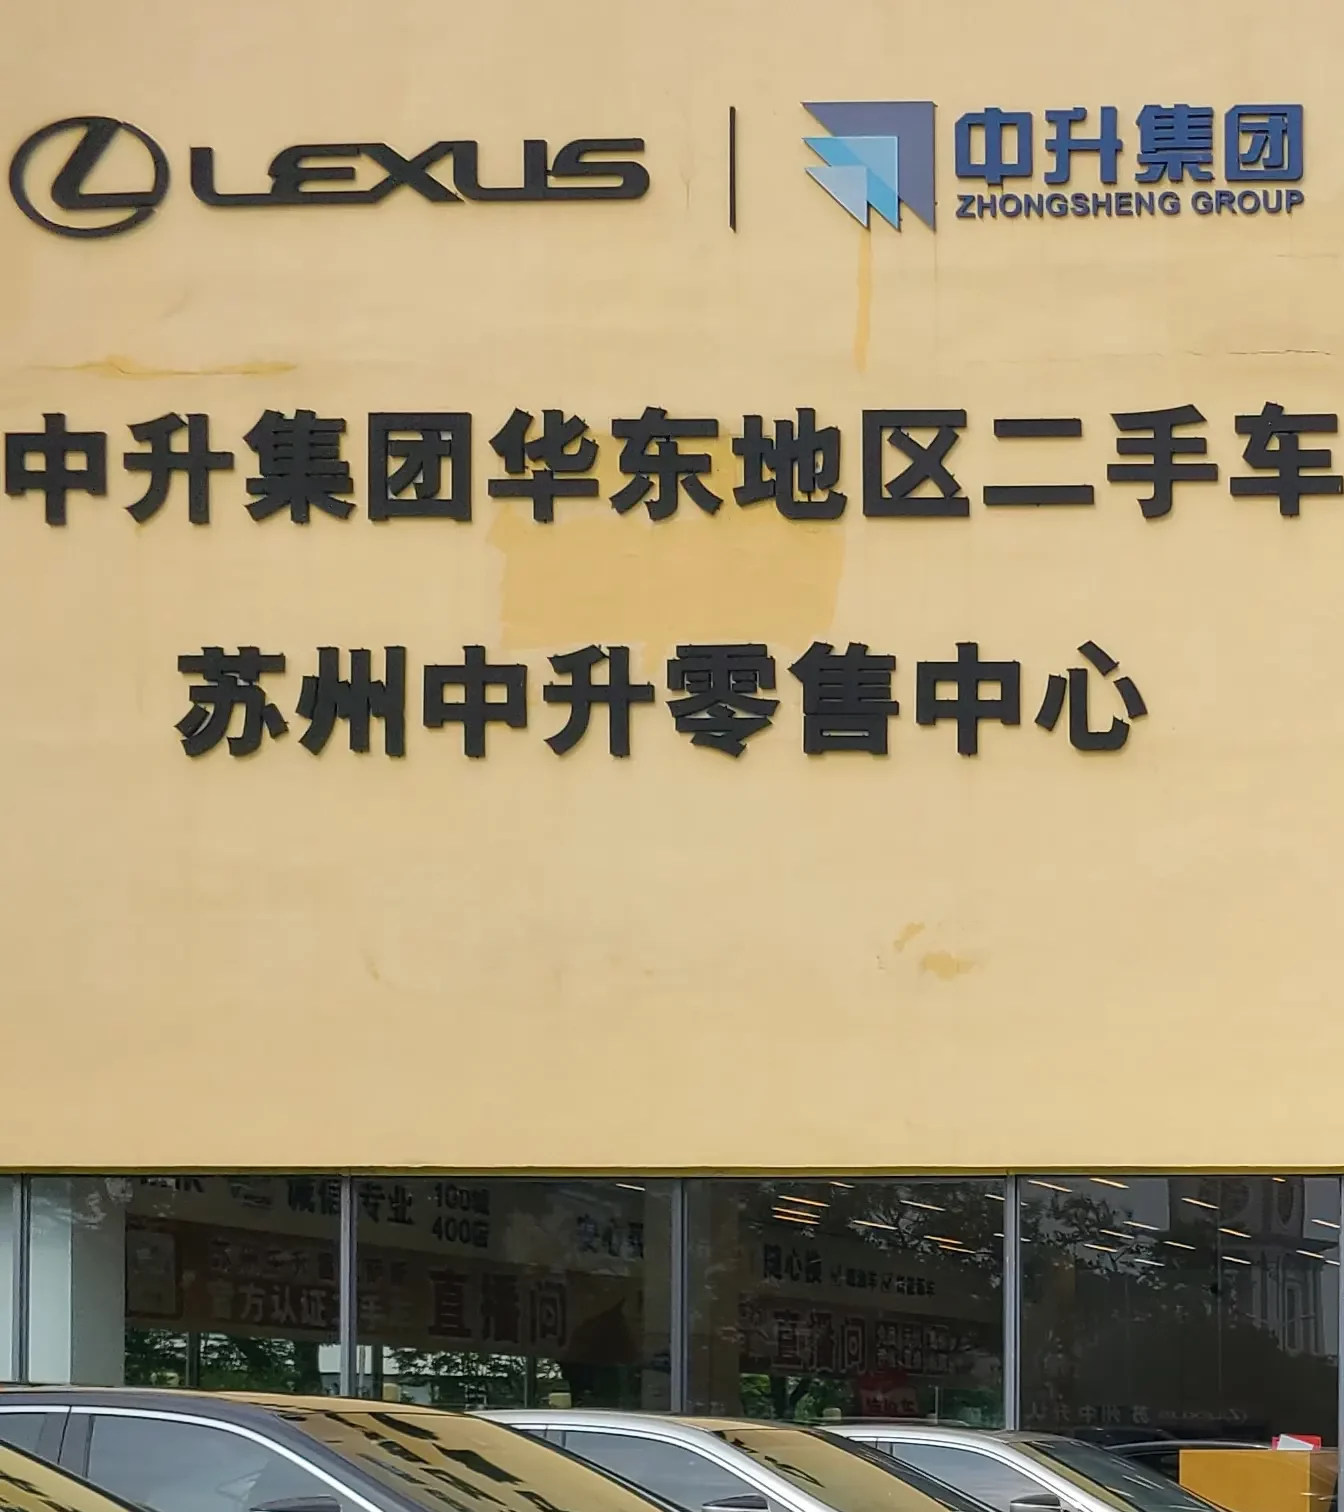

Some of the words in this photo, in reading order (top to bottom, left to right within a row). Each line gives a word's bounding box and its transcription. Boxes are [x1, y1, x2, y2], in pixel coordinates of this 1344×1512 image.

[189, 136, 651, 206] LEXUS
[954, 103, 1304, 187] 中升集团
[955, 191, 1181, 220] ZHONGSHENG
[1191, 187, 1305, 216] GROUP
[4, 401, 1344, 527] 中升集团华东地区二手车
[173, 640, 1148, 760] 苏州中升零售中心
